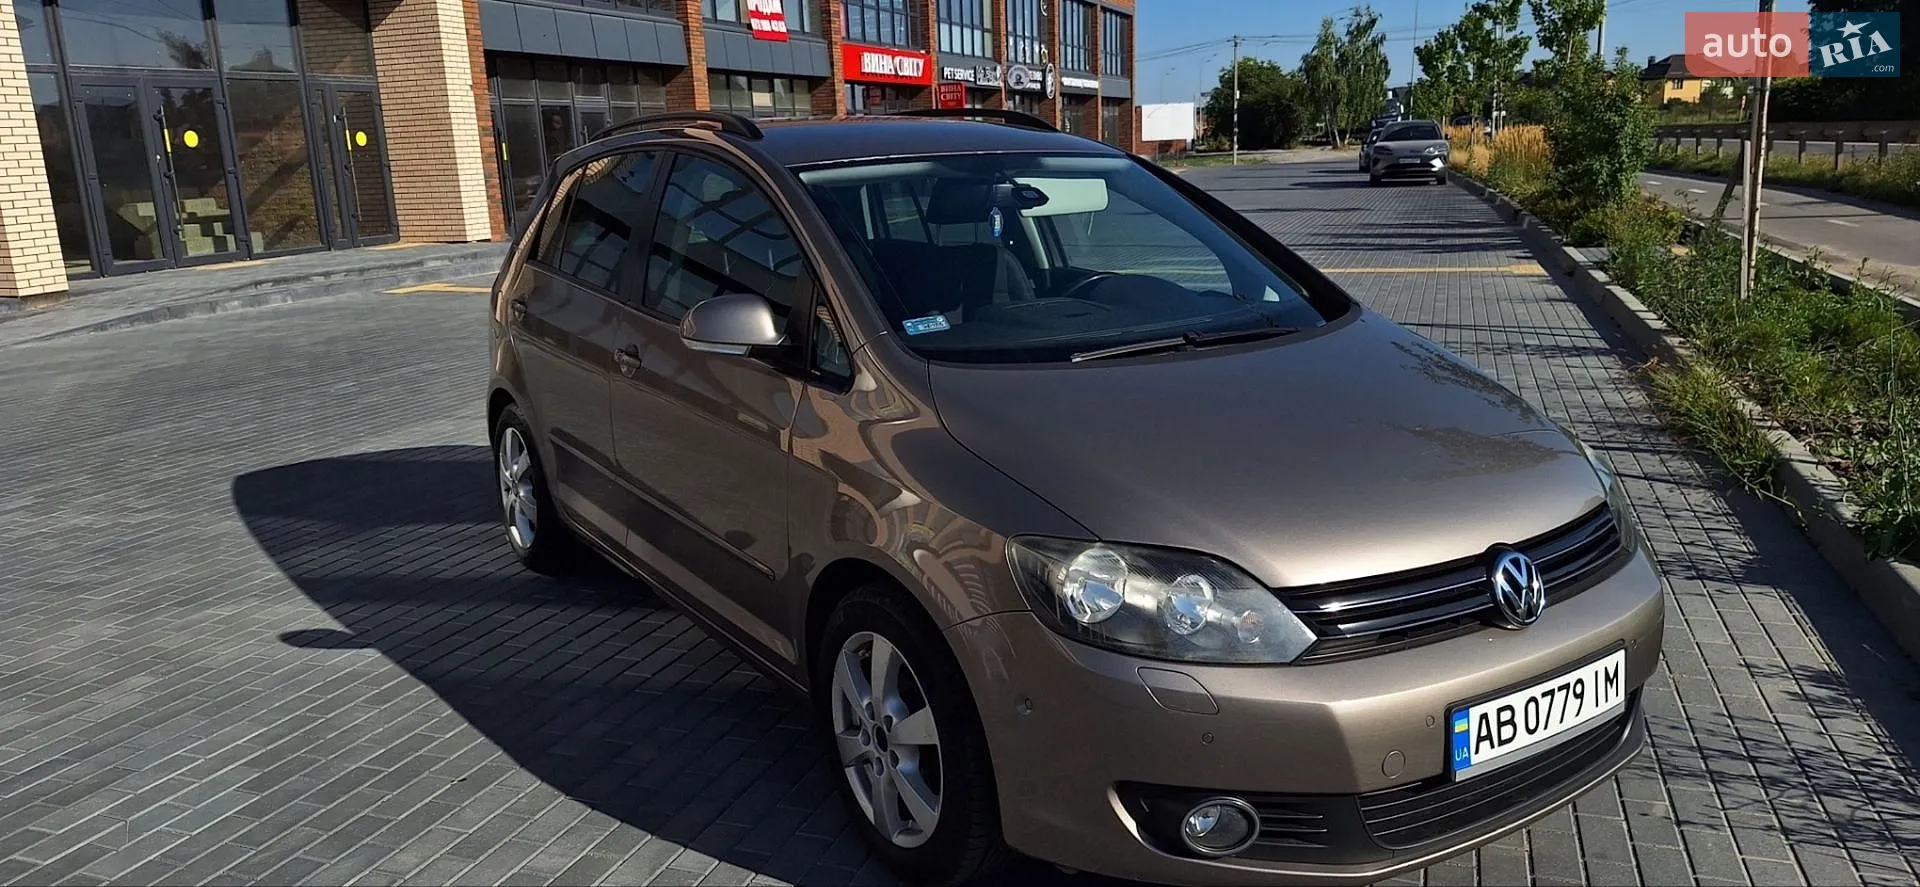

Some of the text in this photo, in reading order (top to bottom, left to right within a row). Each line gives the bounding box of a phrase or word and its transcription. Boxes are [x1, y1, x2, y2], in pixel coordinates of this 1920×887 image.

[861, 52, 895, 75] ВИНА
[1474, 660, 1620, 756] AB 0779 IM
[1455, 748, 1469, 762] UA
